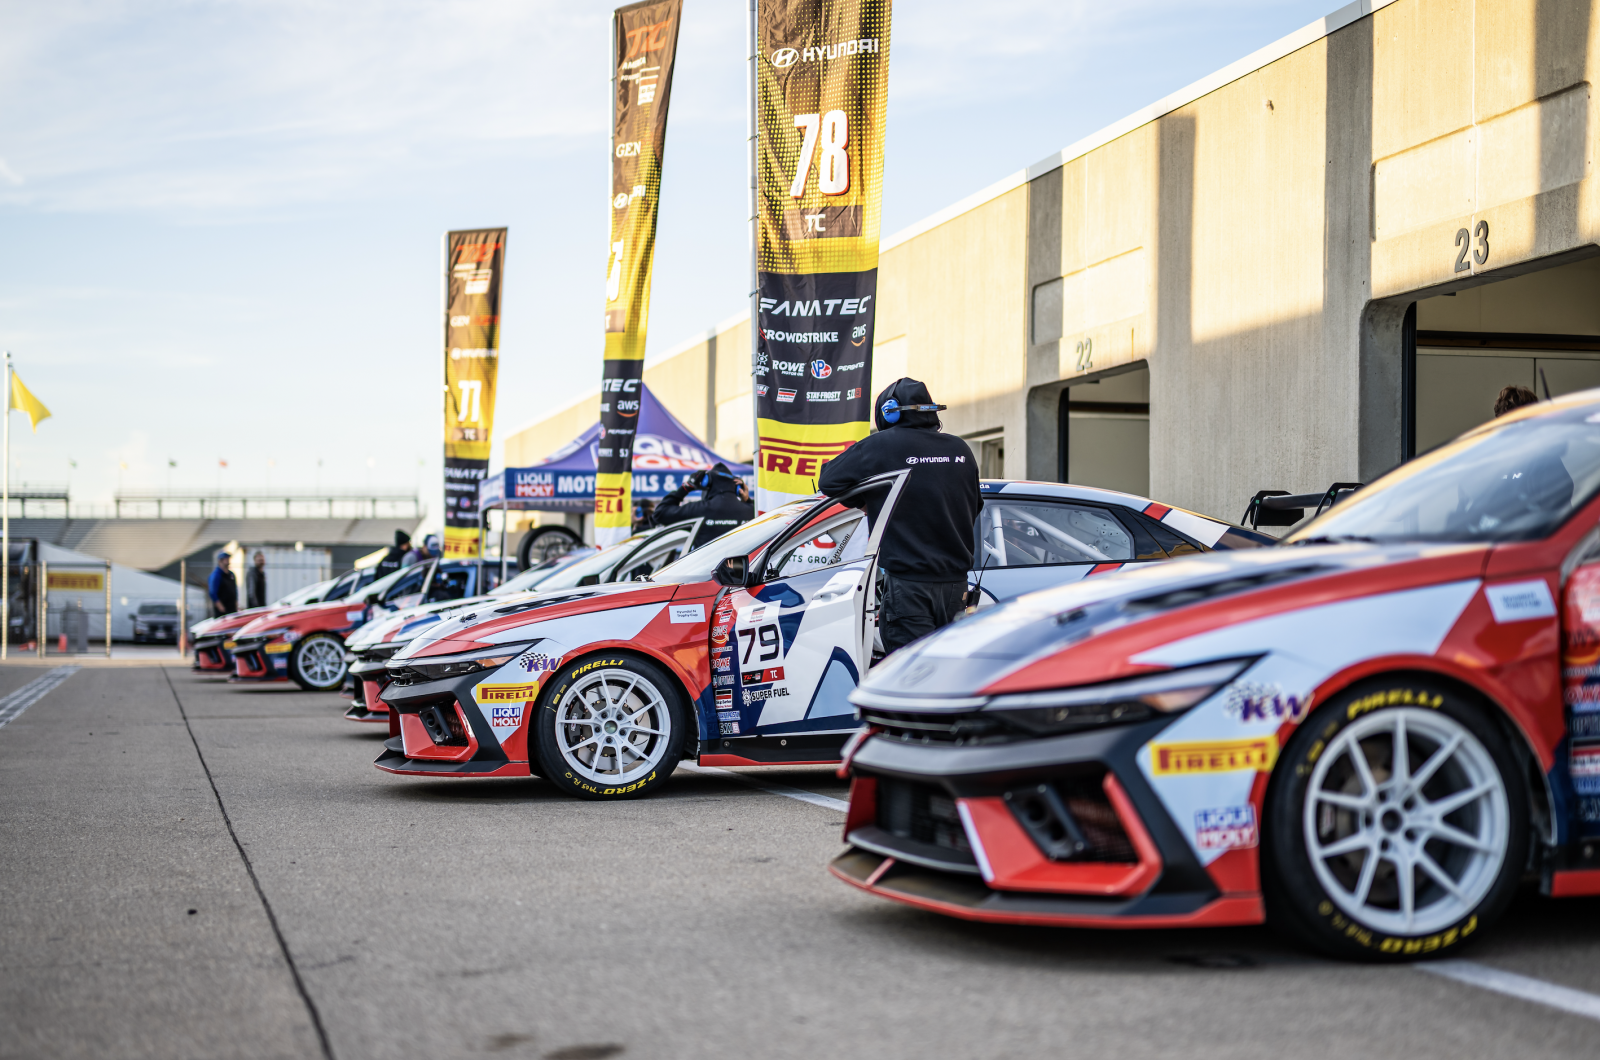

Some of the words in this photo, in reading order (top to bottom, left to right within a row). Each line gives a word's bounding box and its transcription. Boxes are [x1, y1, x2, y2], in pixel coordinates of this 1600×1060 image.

[803, 38, 878, 62] HYUNDAI
[790, 109, 850, 199] 78
[805, 213, 826, 232] TC
[1454, 220, 1489, 273] 23
[759, 295, 871, 317] FANATEC
[852, 324, 867, 339] aws
[1076, 337, 1092, 372] 22
[772, 360, 805, 372] ROWE
[603, 379, 638, 393] TEC
[457, 380, 482, 422] 77
[617, 400, 639, 410] aws
[955, 455, 966, 463] N
[516, 473, 552, 484] LIQUI
[558, 476, 597, 493] MOT
[663, 475, 678, 492] &
[517, 485, 553, 497] MOLY
[833, 534, 851, 559] HYUNDAI
[738, 624, 780, 664] 79
[526, 657, 563, 672] KW
[572, 659, 624, 679] PIRELLI
[711, 657, 731, 669] ROWE
[770, 669, 778, 679] TC
[481, 686, 533, 699] PIRELLI
[750, 690, 773, 701] SUPER
[773, 688, 790, 698] FUEL
[1243, 694, 1314, 723] KW
[1347, 689, 1444, 720] PIRELLI
[494, 708, 520, 718] LIQUI
[494, 717, 520, 727] MOLY
[1159, 742, 1267, 771] PIRELLI
[648, 771, 656, 782] P
[603, 779, 647, 795] ZERO
[1379, 926, 1460, 954] ZERO
